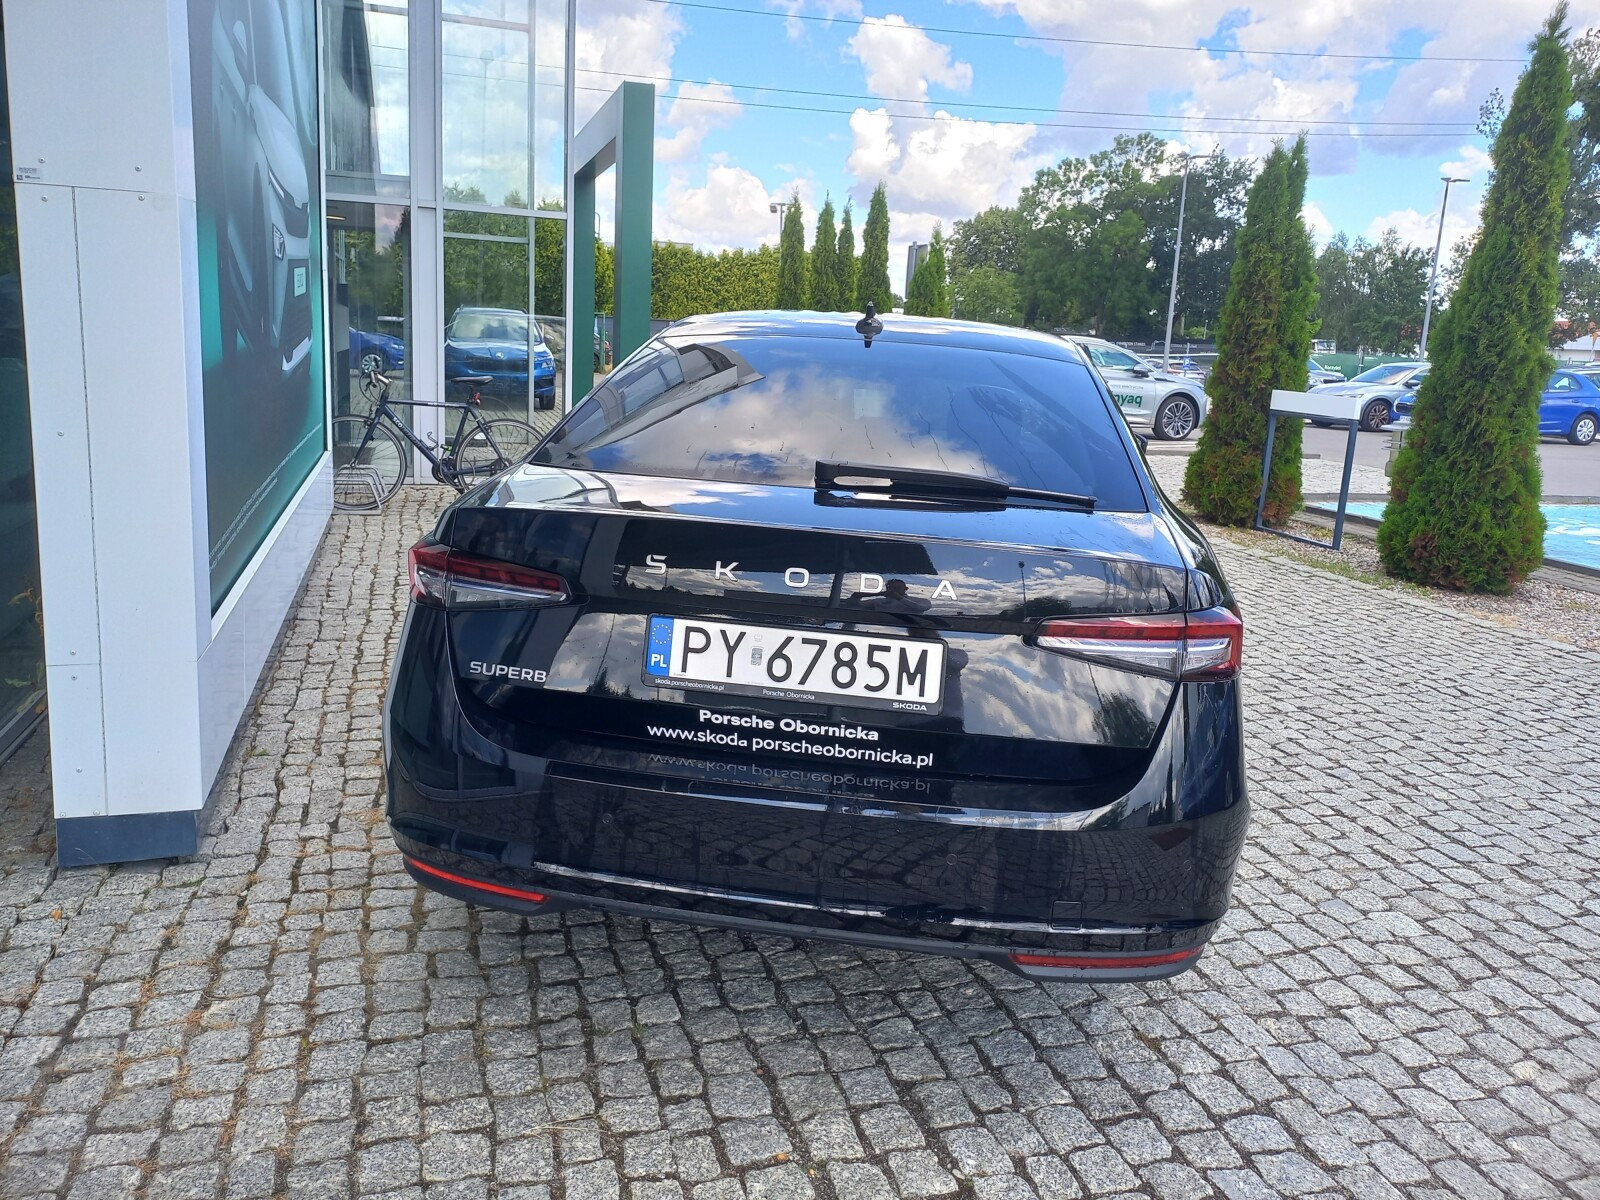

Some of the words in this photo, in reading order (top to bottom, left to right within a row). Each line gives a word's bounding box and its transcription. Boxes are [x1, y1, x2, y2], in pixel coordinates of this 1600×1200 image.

[1113, 393, 1143, 408] nyaq
[645, 554, 958, 601] SKODA
[650, 653, 667, 669] PL
[680, 625, 747, 678] PY
[766, 636, 929, 698] 6785M
[469, 661, 547, 683] SUPERB
[762, 688, 785, 698] Porsche
[786, 691, 815, 701] Obornicka
[892, 701, 928, 712] SKODA
[699, 709, 775, 730] Porsche
[779, 717, 879, 741] Obornicka
